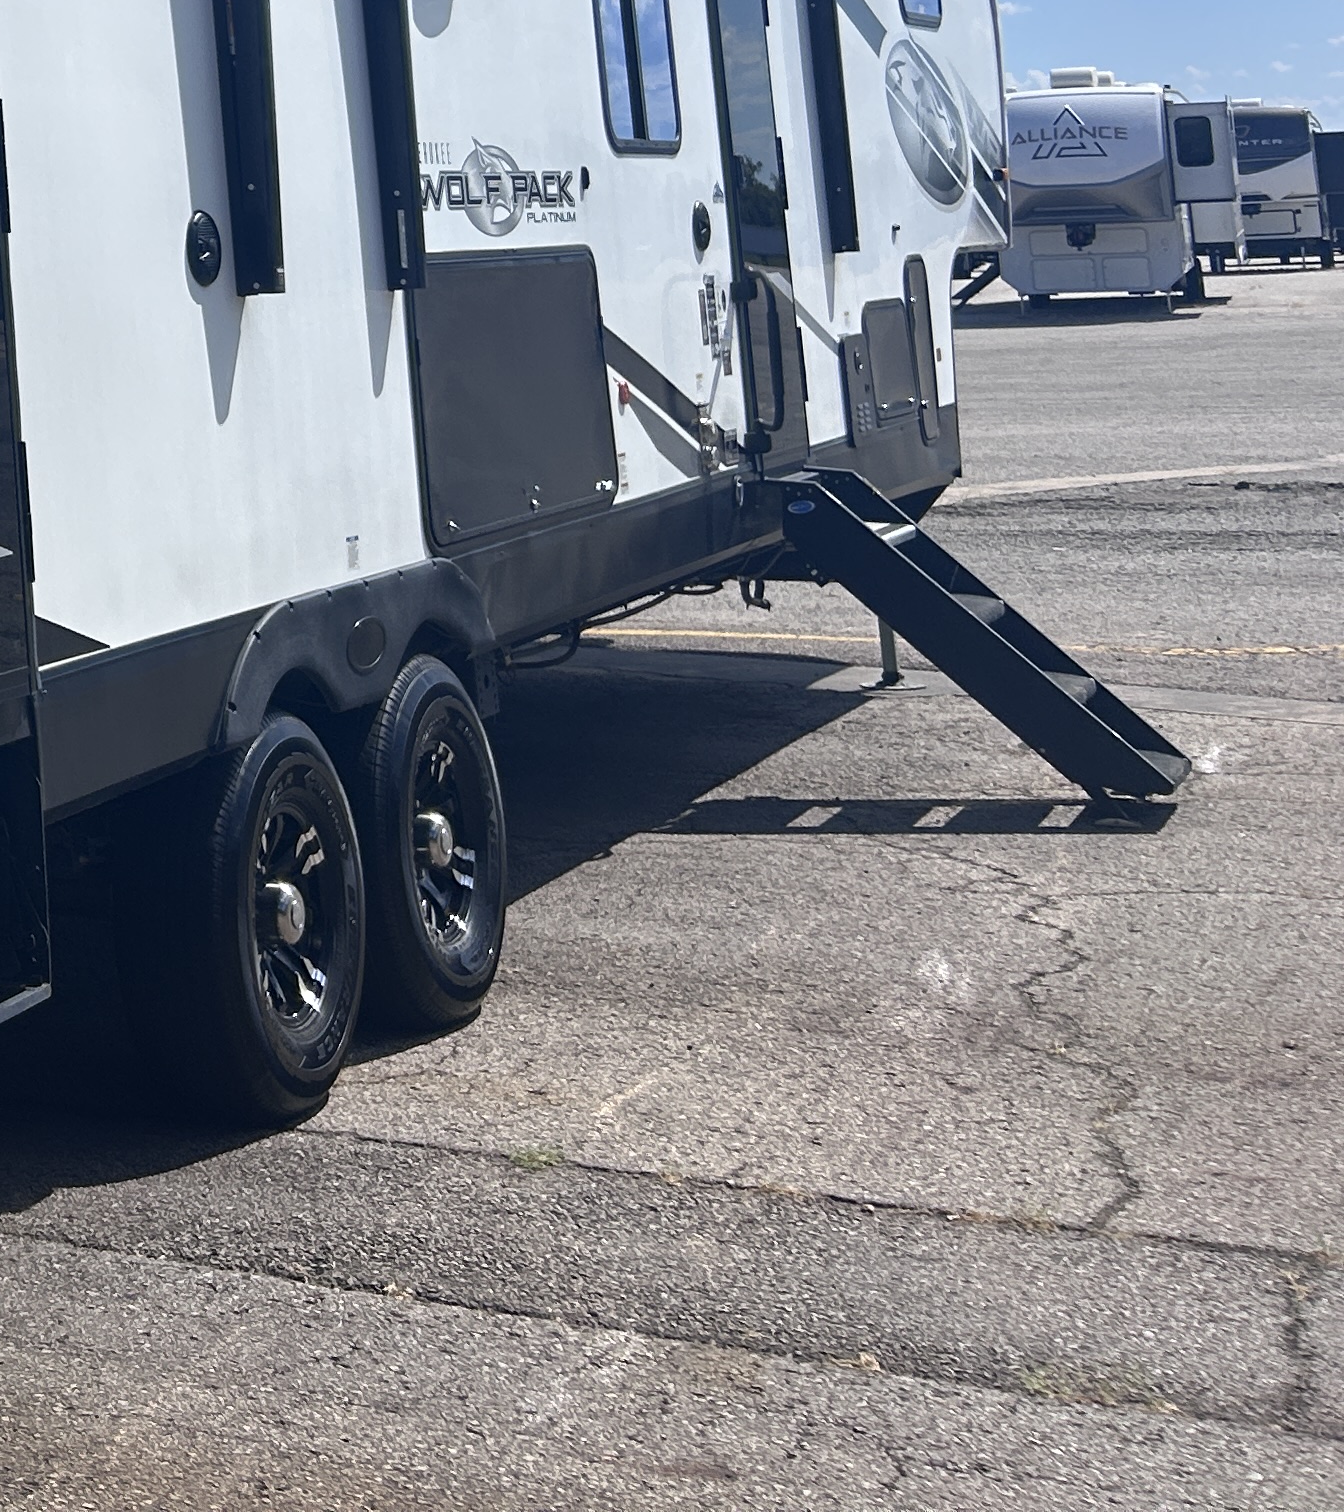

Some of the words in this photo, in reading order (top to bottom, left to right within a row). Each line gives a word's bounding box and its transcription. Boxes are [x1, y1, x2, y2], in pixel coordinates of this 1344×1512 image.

[1011, 125, 1129, 146] ALLIANCE
[1238, 138, 1283, 146] NTER
[420, 170, 503, 211] WOLF
[507, 170, 576, 209] PACK
[525, 211, 577, 224] PLATINUM
